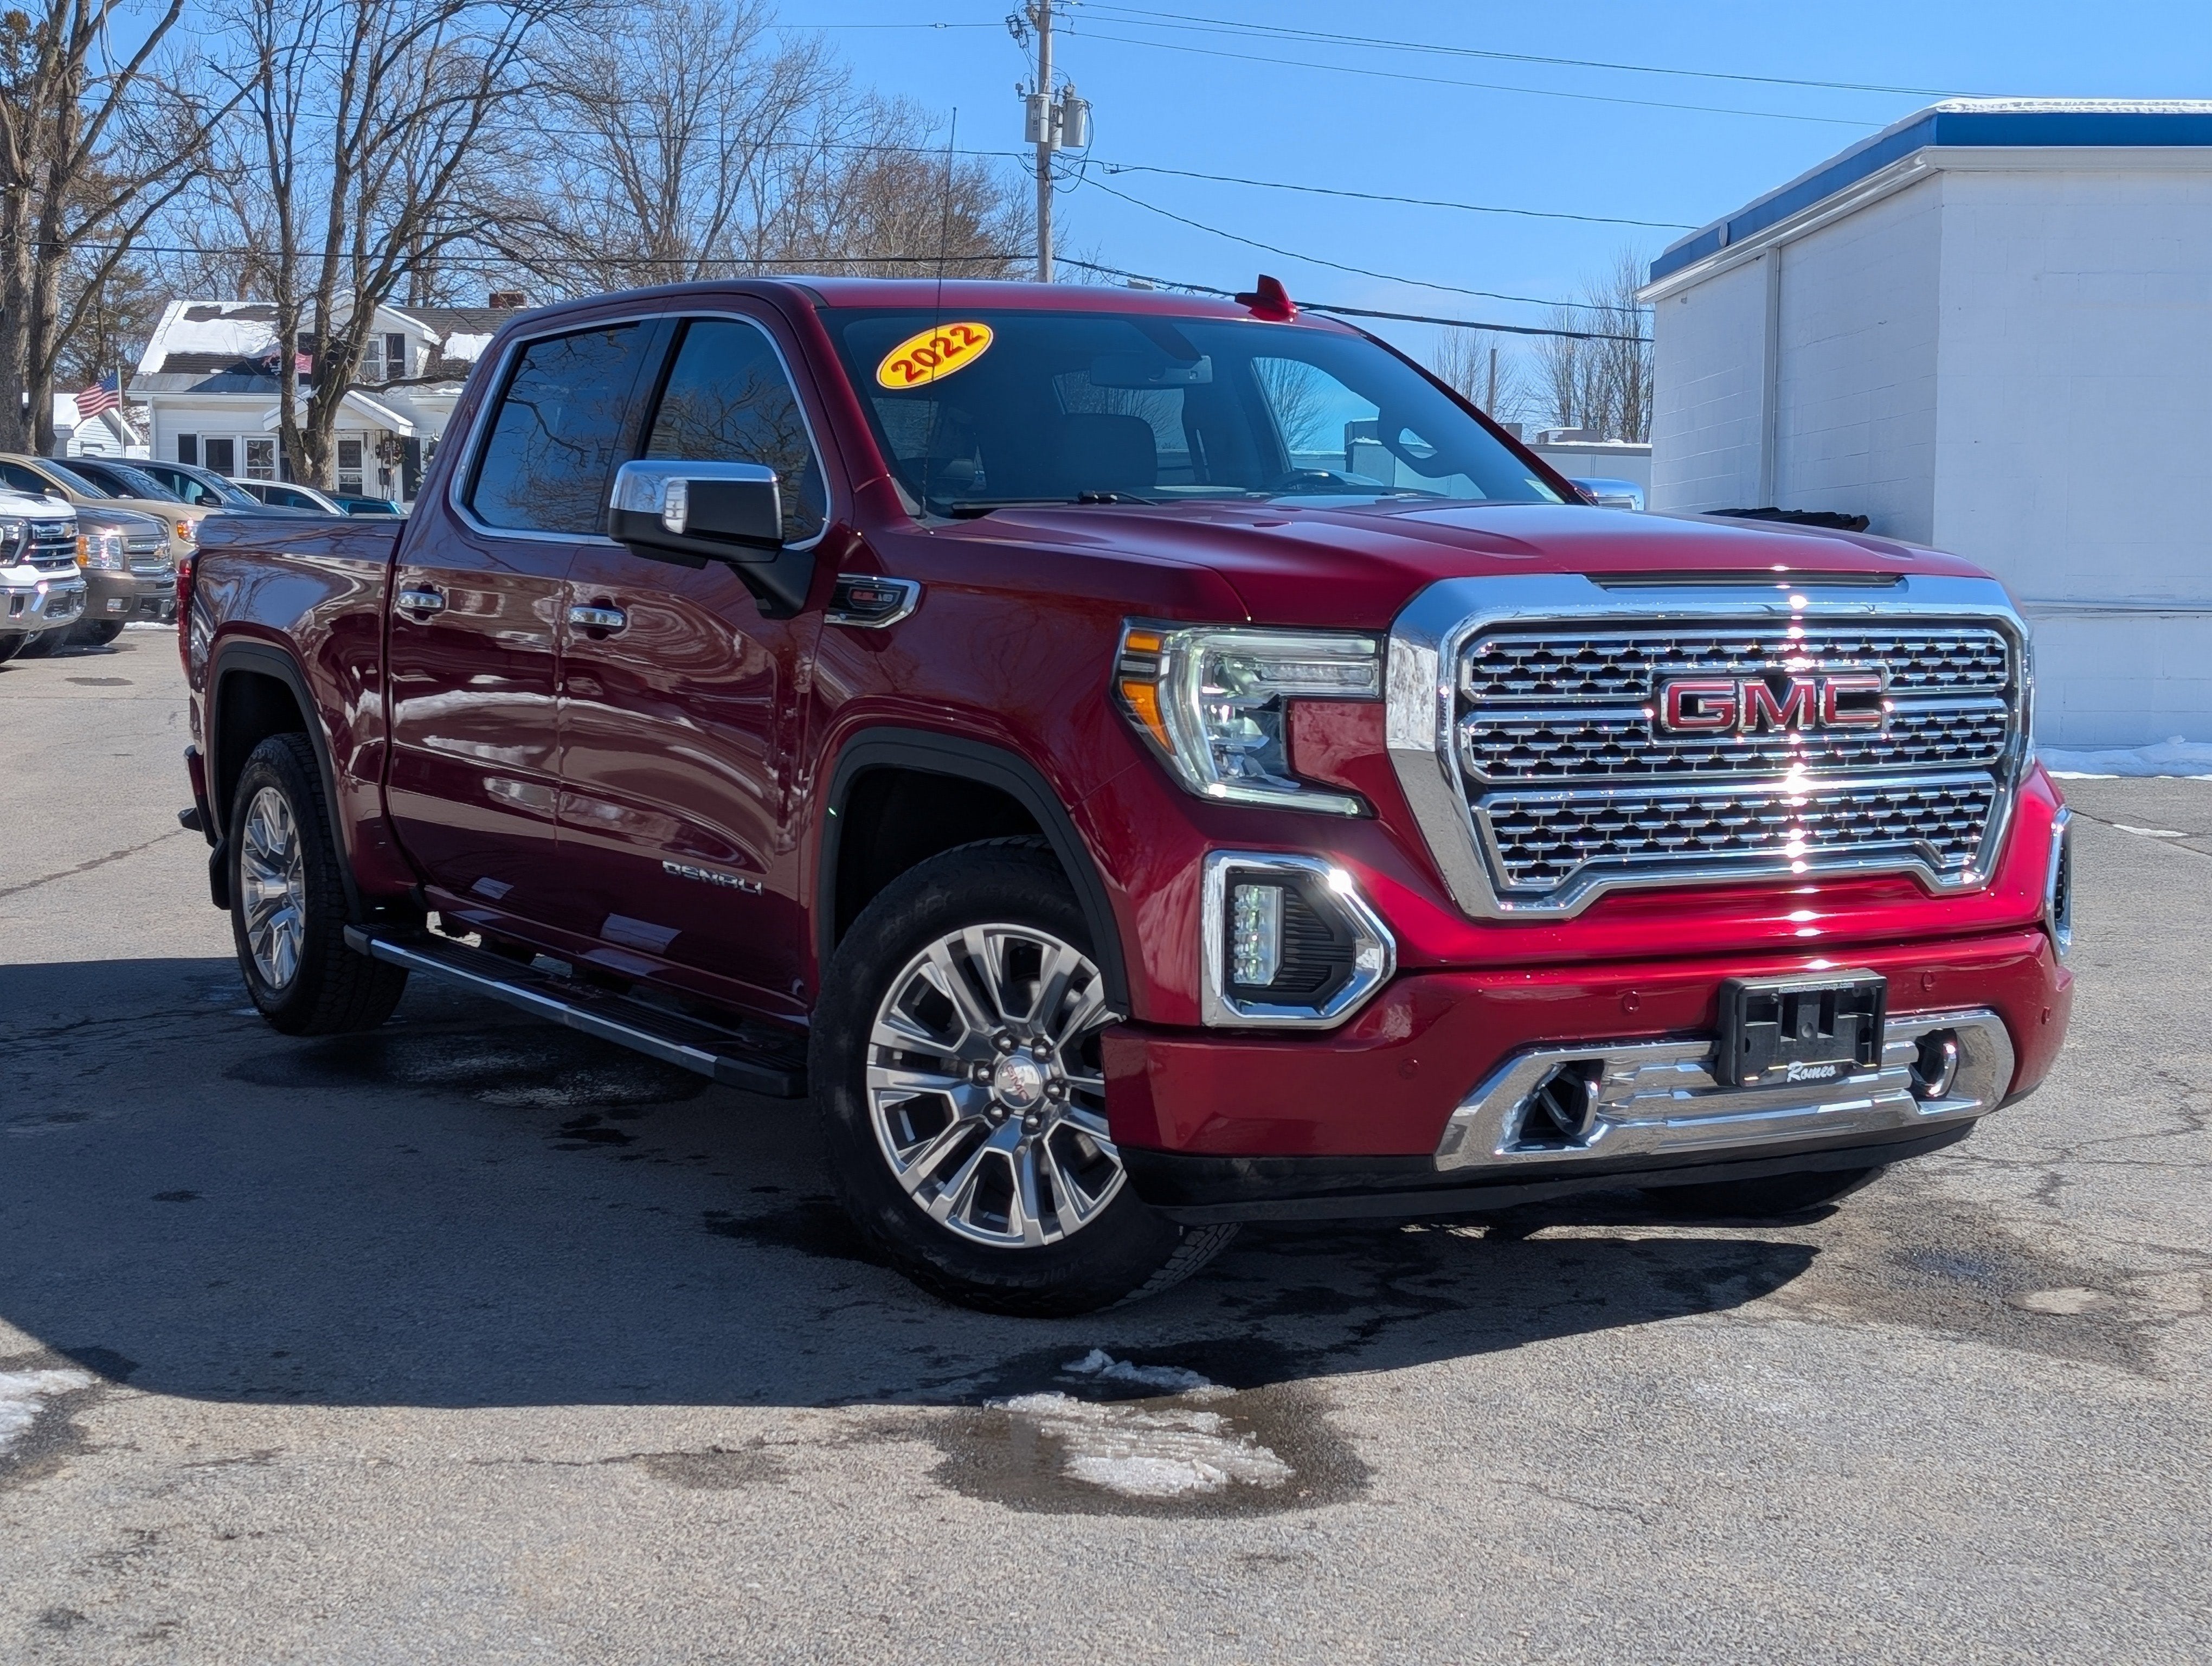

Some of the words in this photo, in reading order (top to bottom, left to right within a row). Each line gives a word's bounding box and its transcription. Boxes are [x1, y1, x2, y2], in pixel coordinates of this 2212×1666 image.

[891, 326, 985, 382] 2022
[1660, 676, 1882, 733] GMC
[663, 860, 762, 895] DENALI
[1006, 1064, 1030, 1101] GMC
[1786, 1061, 1836, 1082] Romeo
